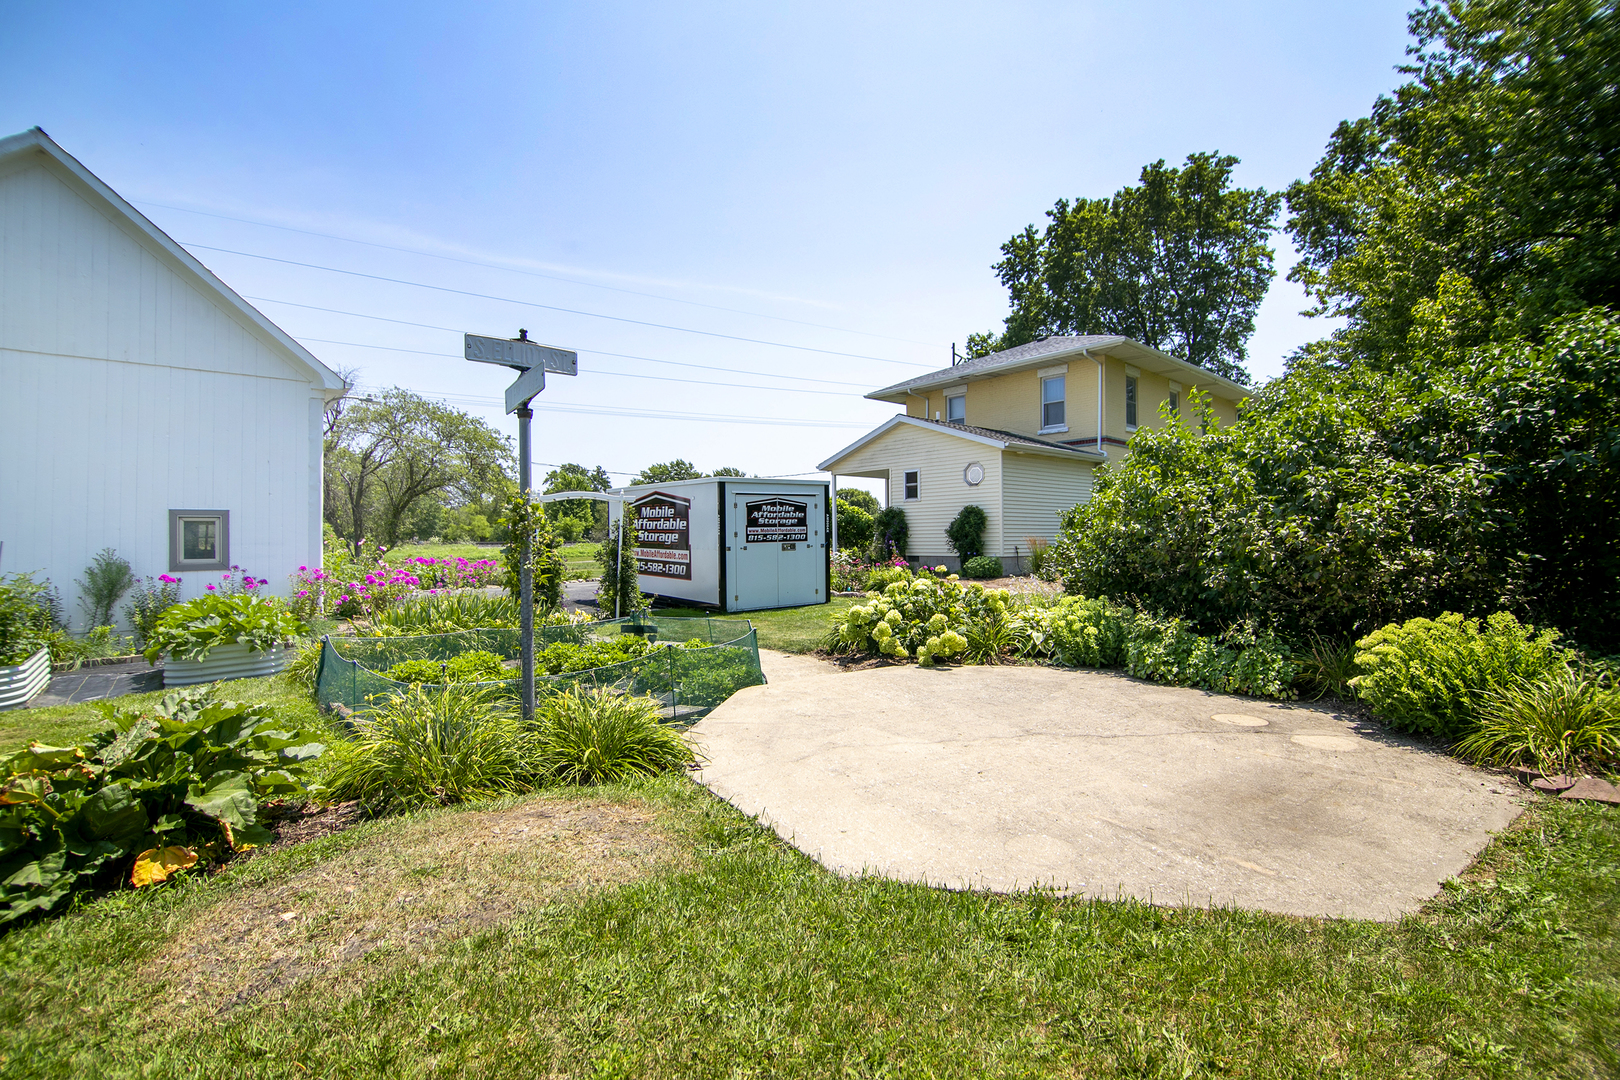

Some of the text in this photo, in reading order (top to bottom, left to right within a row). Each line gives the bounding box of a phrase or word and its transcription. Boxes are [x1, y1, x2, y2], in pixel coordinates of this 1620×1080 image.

[640, 506, 675, 518] Mobile
[633, 518, 687, 530] Affordable
[638, 530, 679, 544] Storage
[636, 561, 687, 575] 15-582-1300
